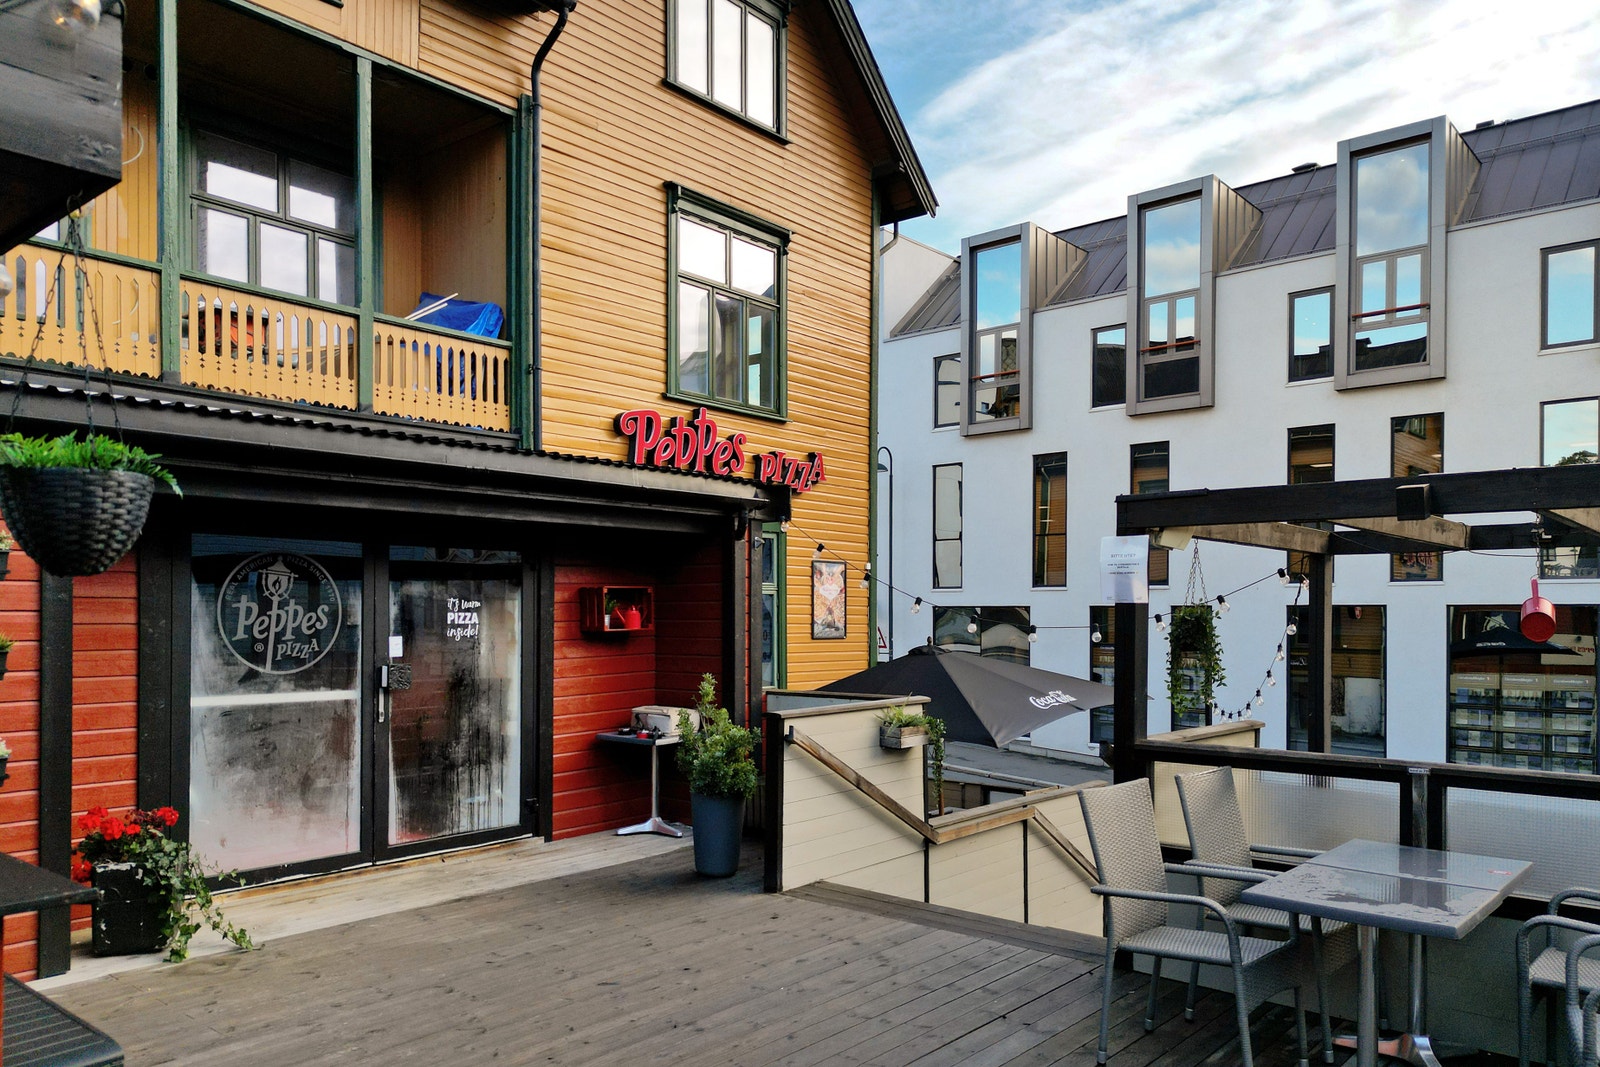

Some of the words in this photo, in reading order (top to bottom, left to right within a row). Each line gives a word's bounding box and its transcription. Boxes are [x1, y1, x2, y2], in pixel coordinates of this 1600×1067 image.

[619, 407, 747, 475] Peppes
[759, 451, 826, 493] PIZZA
[225, 581, 239, 601] REAL
[237, 555, 273, 581] AMERICAN
[286, 555, 308, 568] PIZZA
[309, 565, 328, 585] SINCE
[231, 594, 330, 642] Peppes
[446, 624, 479, 642] inside!
[447, 612, 479, 624] PIZZA
[275, 638, 320, 661] PIZZA
